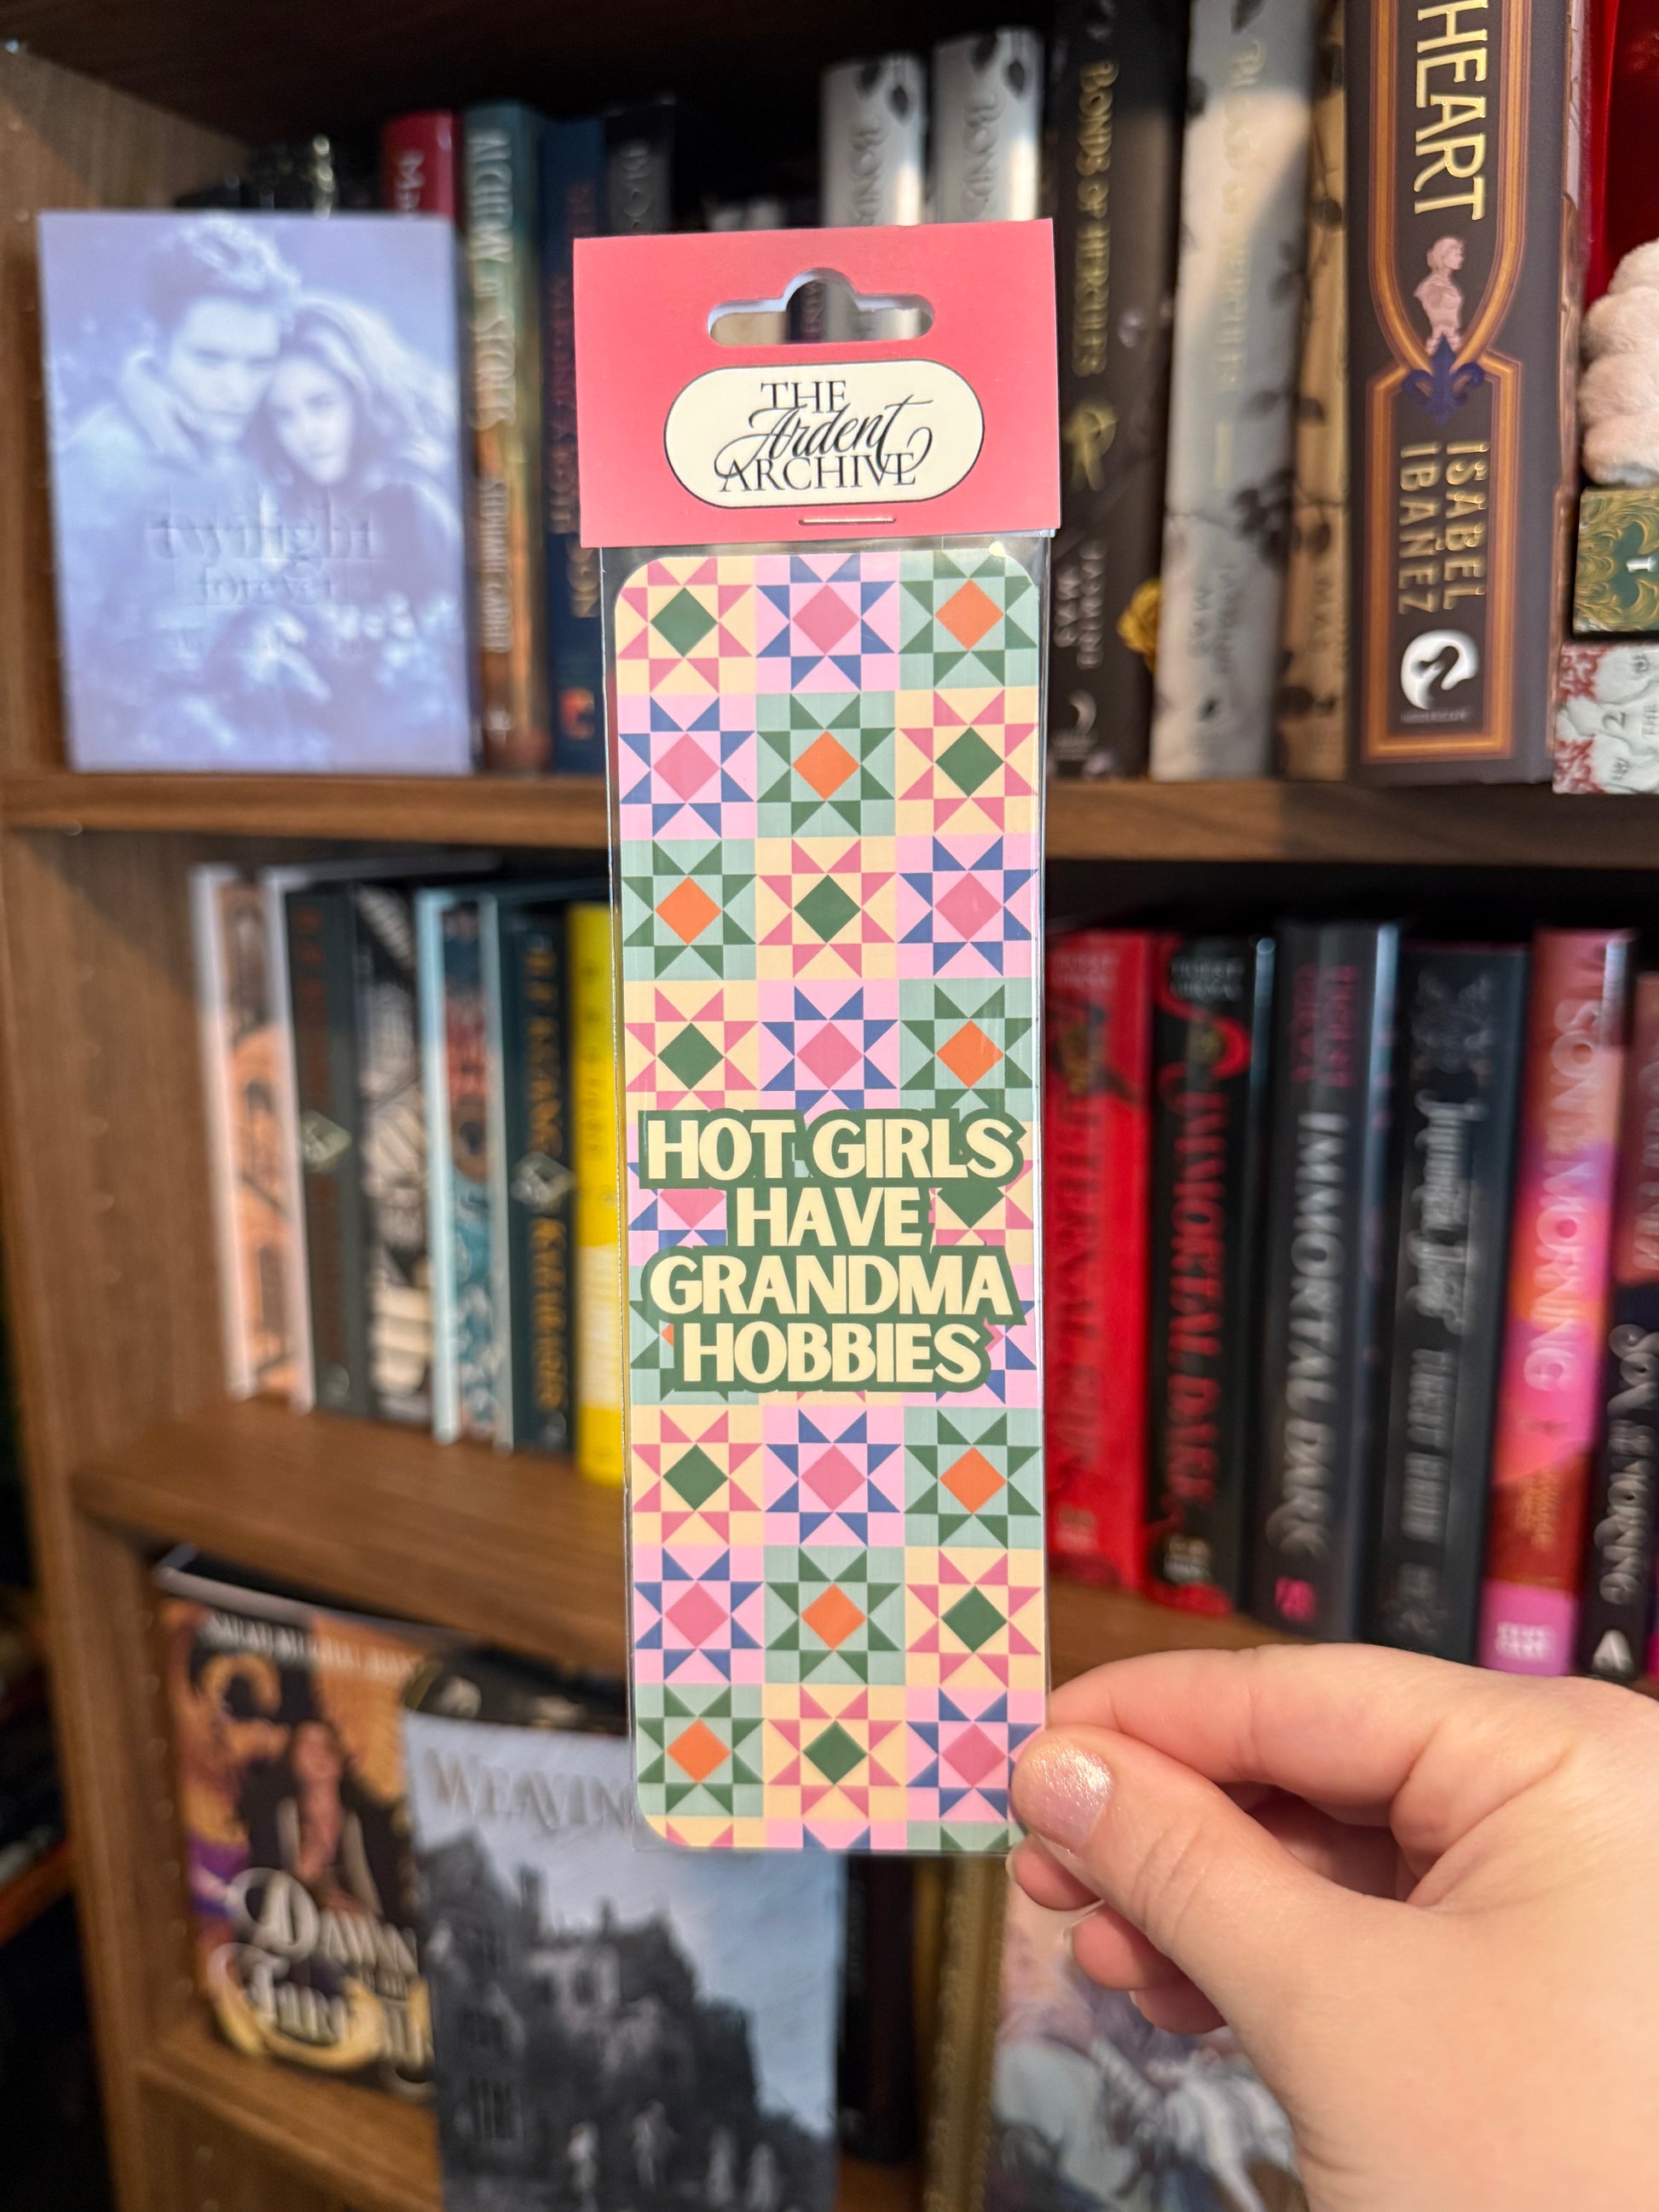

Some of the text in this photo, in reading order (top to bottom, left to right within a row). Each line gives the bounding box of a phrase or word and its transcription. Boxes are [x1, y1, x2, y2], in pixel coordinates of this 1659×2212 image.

[1076, 60, 1119, 177] BONDS
[1414, 0, 1488, 221] HEART
[760, 380, 847, 414] THE
[714, 394, 934, 478] Ardent
[720, 452, 916, 493] ARCHIVE
[147, 500, 377, 576] twilight
[1398, 441, 1446, 615] IBAÑEZ
[1443, 442, 1489, 610] ISABEL
[1600, 708, 1627, 732] 2
[648, 1118, 1014, 1181] HOT GIRLS
[737, 1187, 922, 1246] HAVE
[650, 1255, 1013, 1315] GRANDMA
[683, 1321, 982, 1383] HOBBIES
[1266, 1111, 1349, 1565] IMMORTAL DARK
